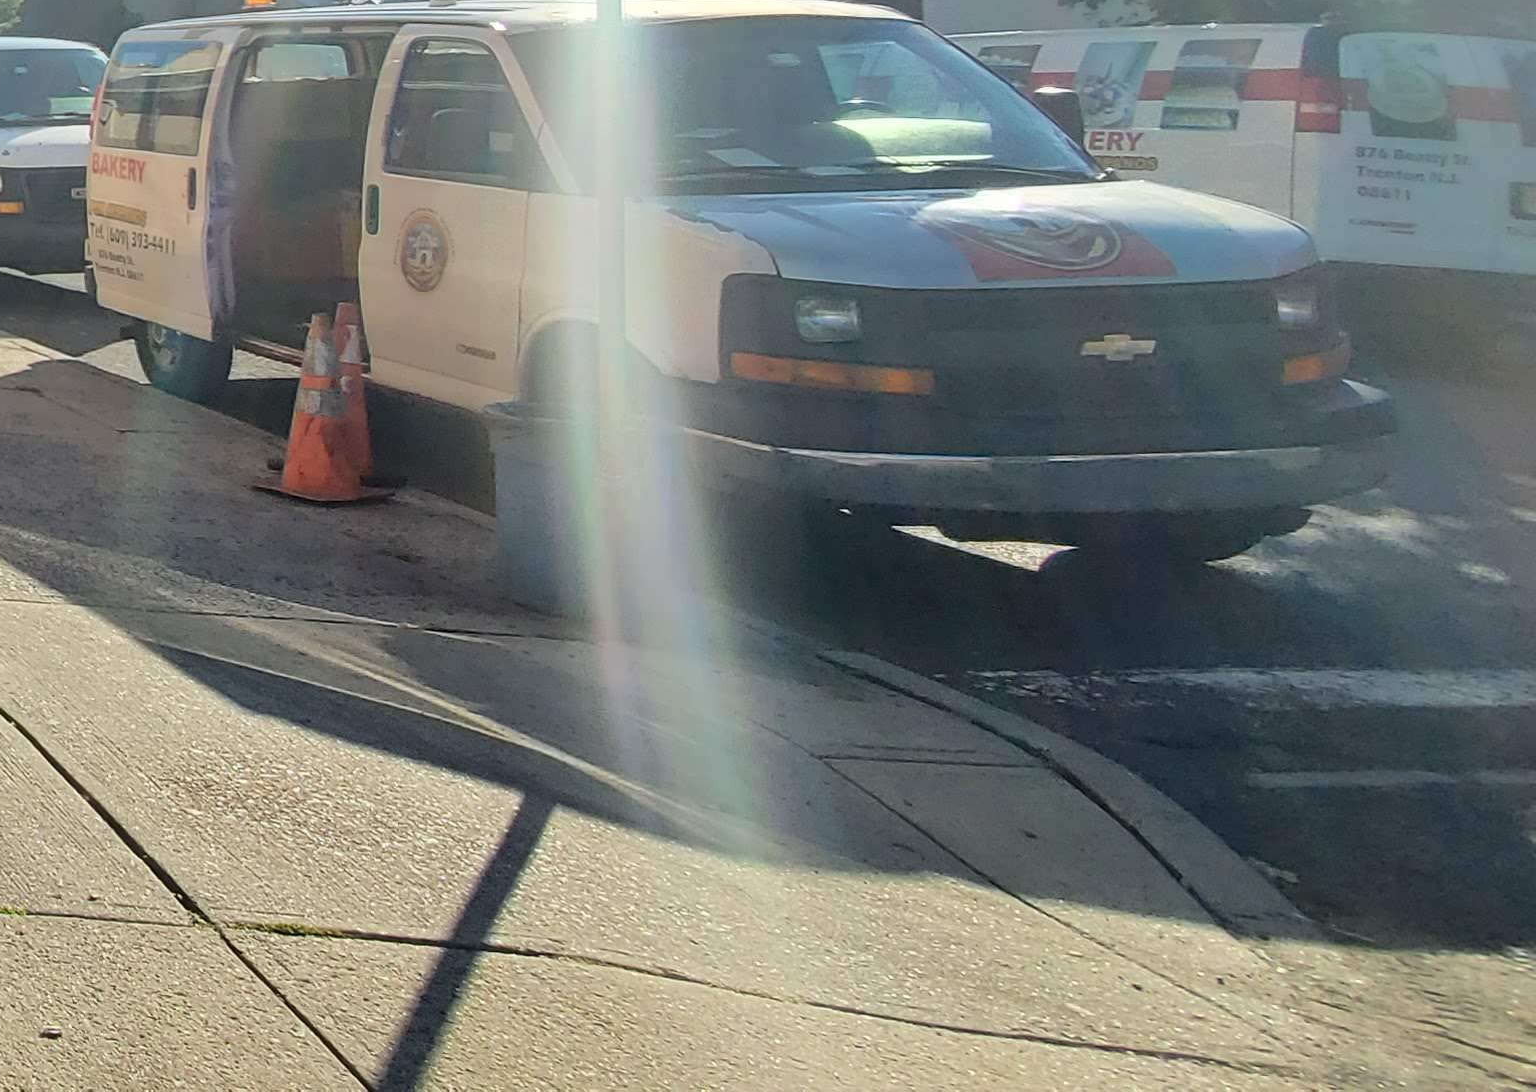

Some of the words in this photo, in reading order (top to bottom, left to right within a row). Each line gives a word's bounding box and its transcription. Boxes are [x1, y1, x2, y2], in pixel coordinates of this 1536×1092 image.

[1088, 130, 1145, 151] ERY
[92, 152, 146, 183] BAKERY
[131, 231, 176, 257] 393-4411
